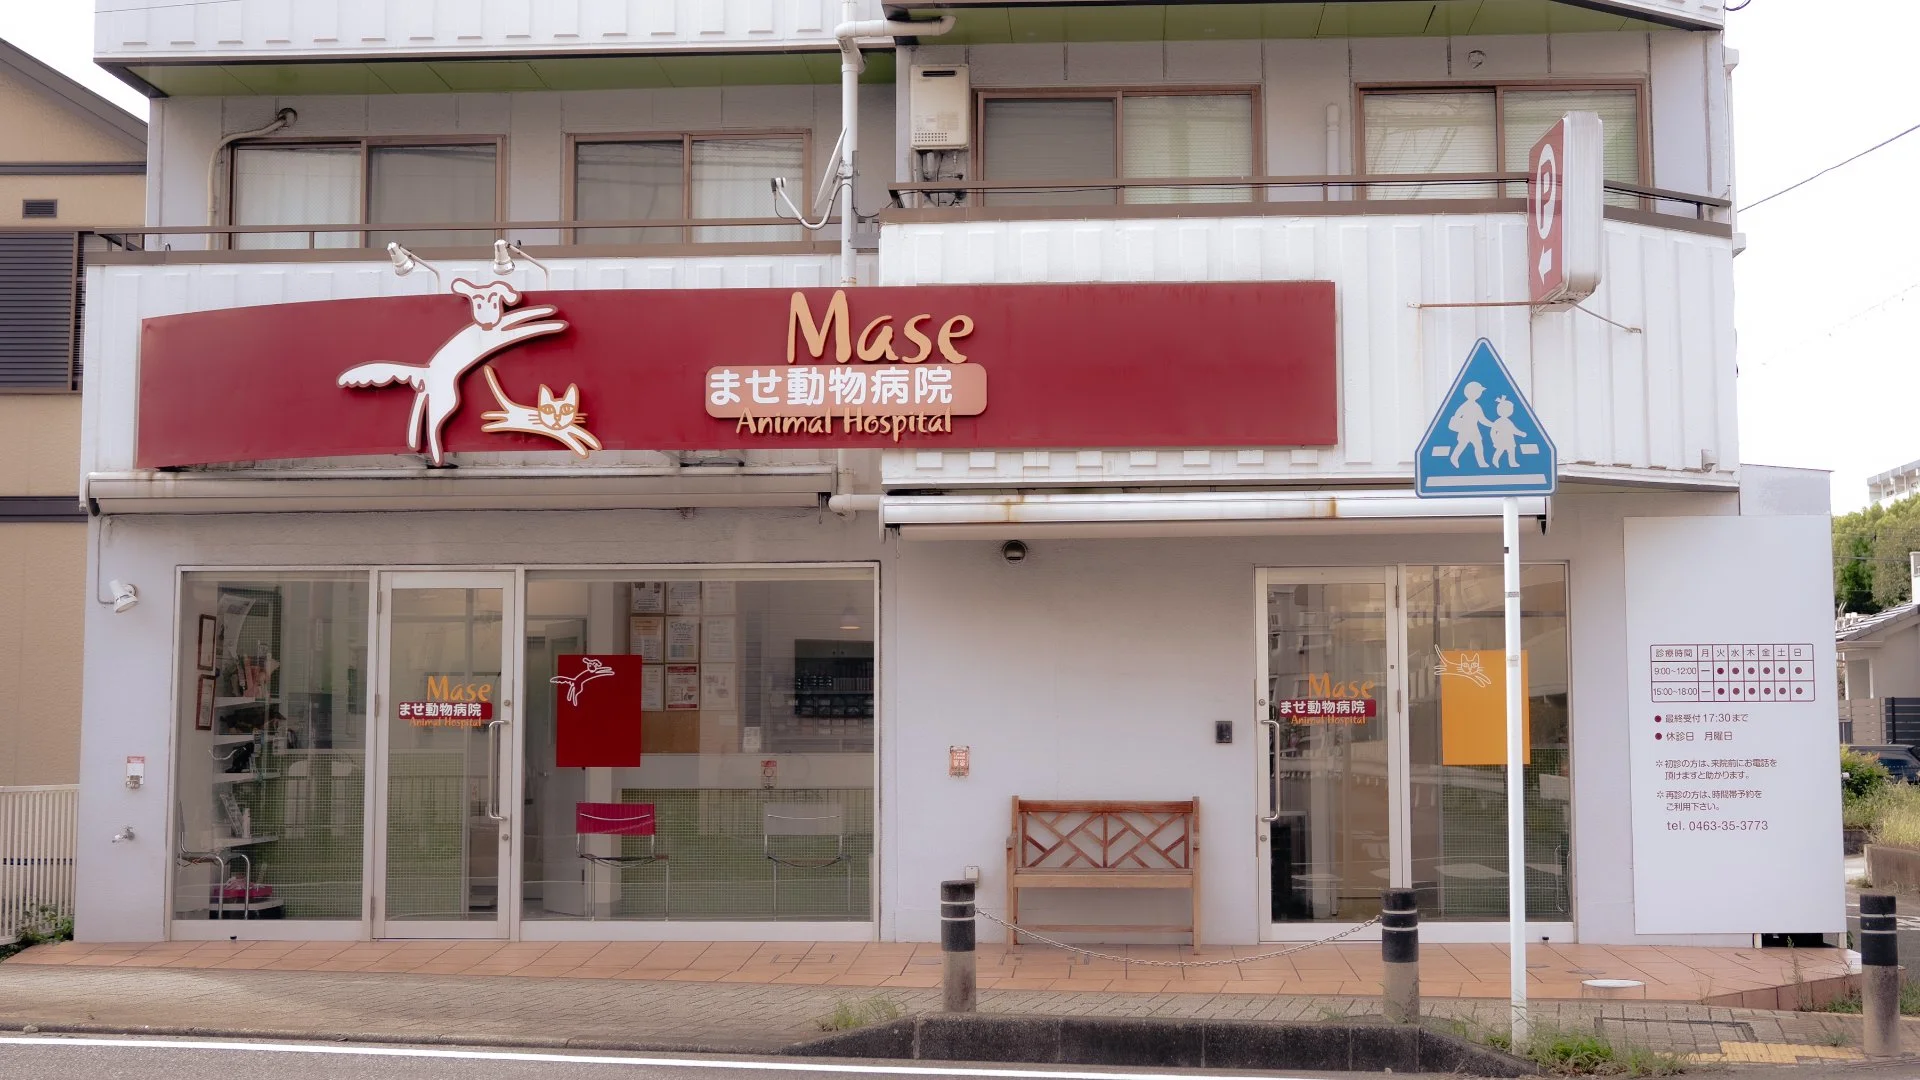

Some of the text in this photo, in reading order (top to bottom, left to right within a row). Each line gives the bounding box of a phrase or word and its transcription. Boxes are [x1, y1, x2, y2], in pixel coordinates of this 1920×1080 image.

[787, 290, 974, 364] Mase
[710, 367, 953, 406] ませ動物病院
[736, 407, 952, 443] Animal Hospital
[1656, 649, 1692, 658] 診療時間
[1701, 649, 1709, 657] 月
[1717, 649, 1725, 657] 火
[1731, 649, 1740, 657] 水
[1762, 648, 1770, 657] 金
[1778, 648, 1786, 656] 土
[1794, 648, 1802, 657] 日
[427, 675, 491, 701] Mase
[1308, 672, 1374, 698] Mase
[400, 703, 481, 716] ませ動物病院
[1281, 701, 1365, 714] ませ動物病院
[410, 717, 481, 728] Animal Hospital
[1291, 715, 1366, 726] Animal Hospital
[1666, 732, 1732, 741] 休診日 月曜日
[1667, 821, 1768, 830] tel. 0463-35-3773
